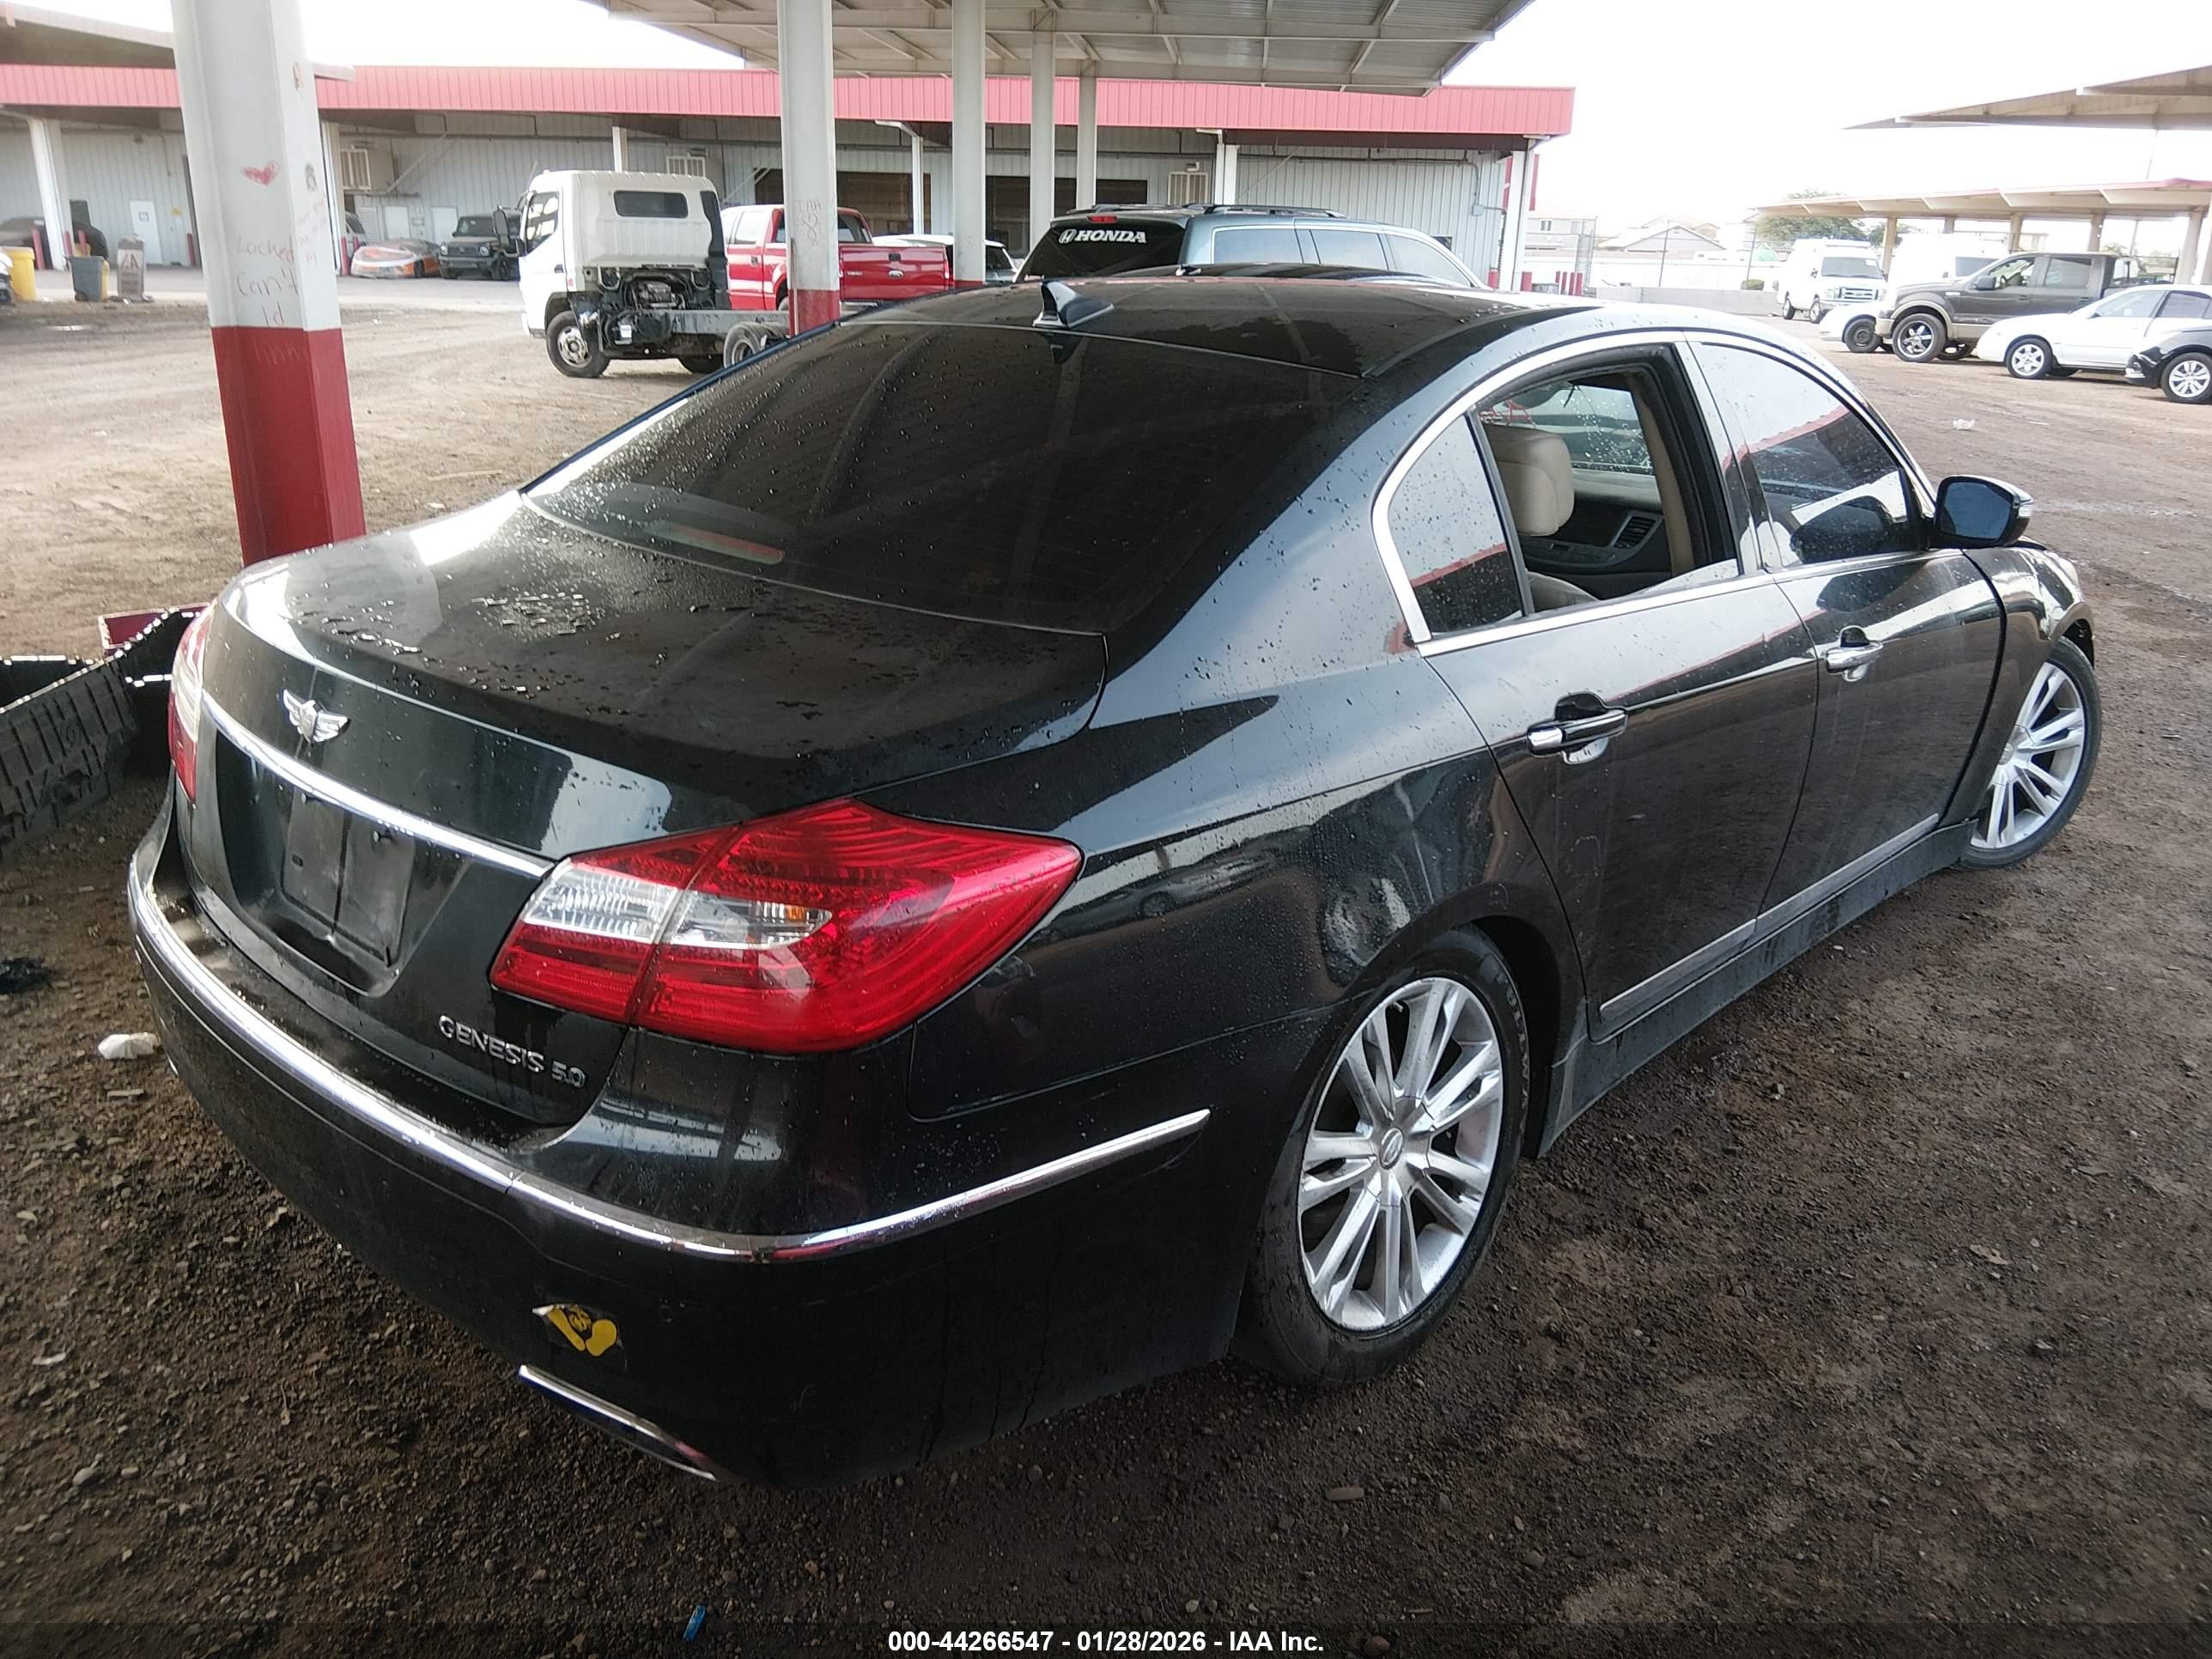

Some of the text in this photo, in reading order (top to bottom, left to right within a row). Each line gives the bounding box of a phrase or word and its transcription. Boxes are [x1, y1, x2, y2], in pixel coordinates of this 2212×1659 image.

[1074, 229, 1147, 244] HONDA
[235, 267, 300, 296] Can't
[439, 1015, 544, 1073] GENESIS
